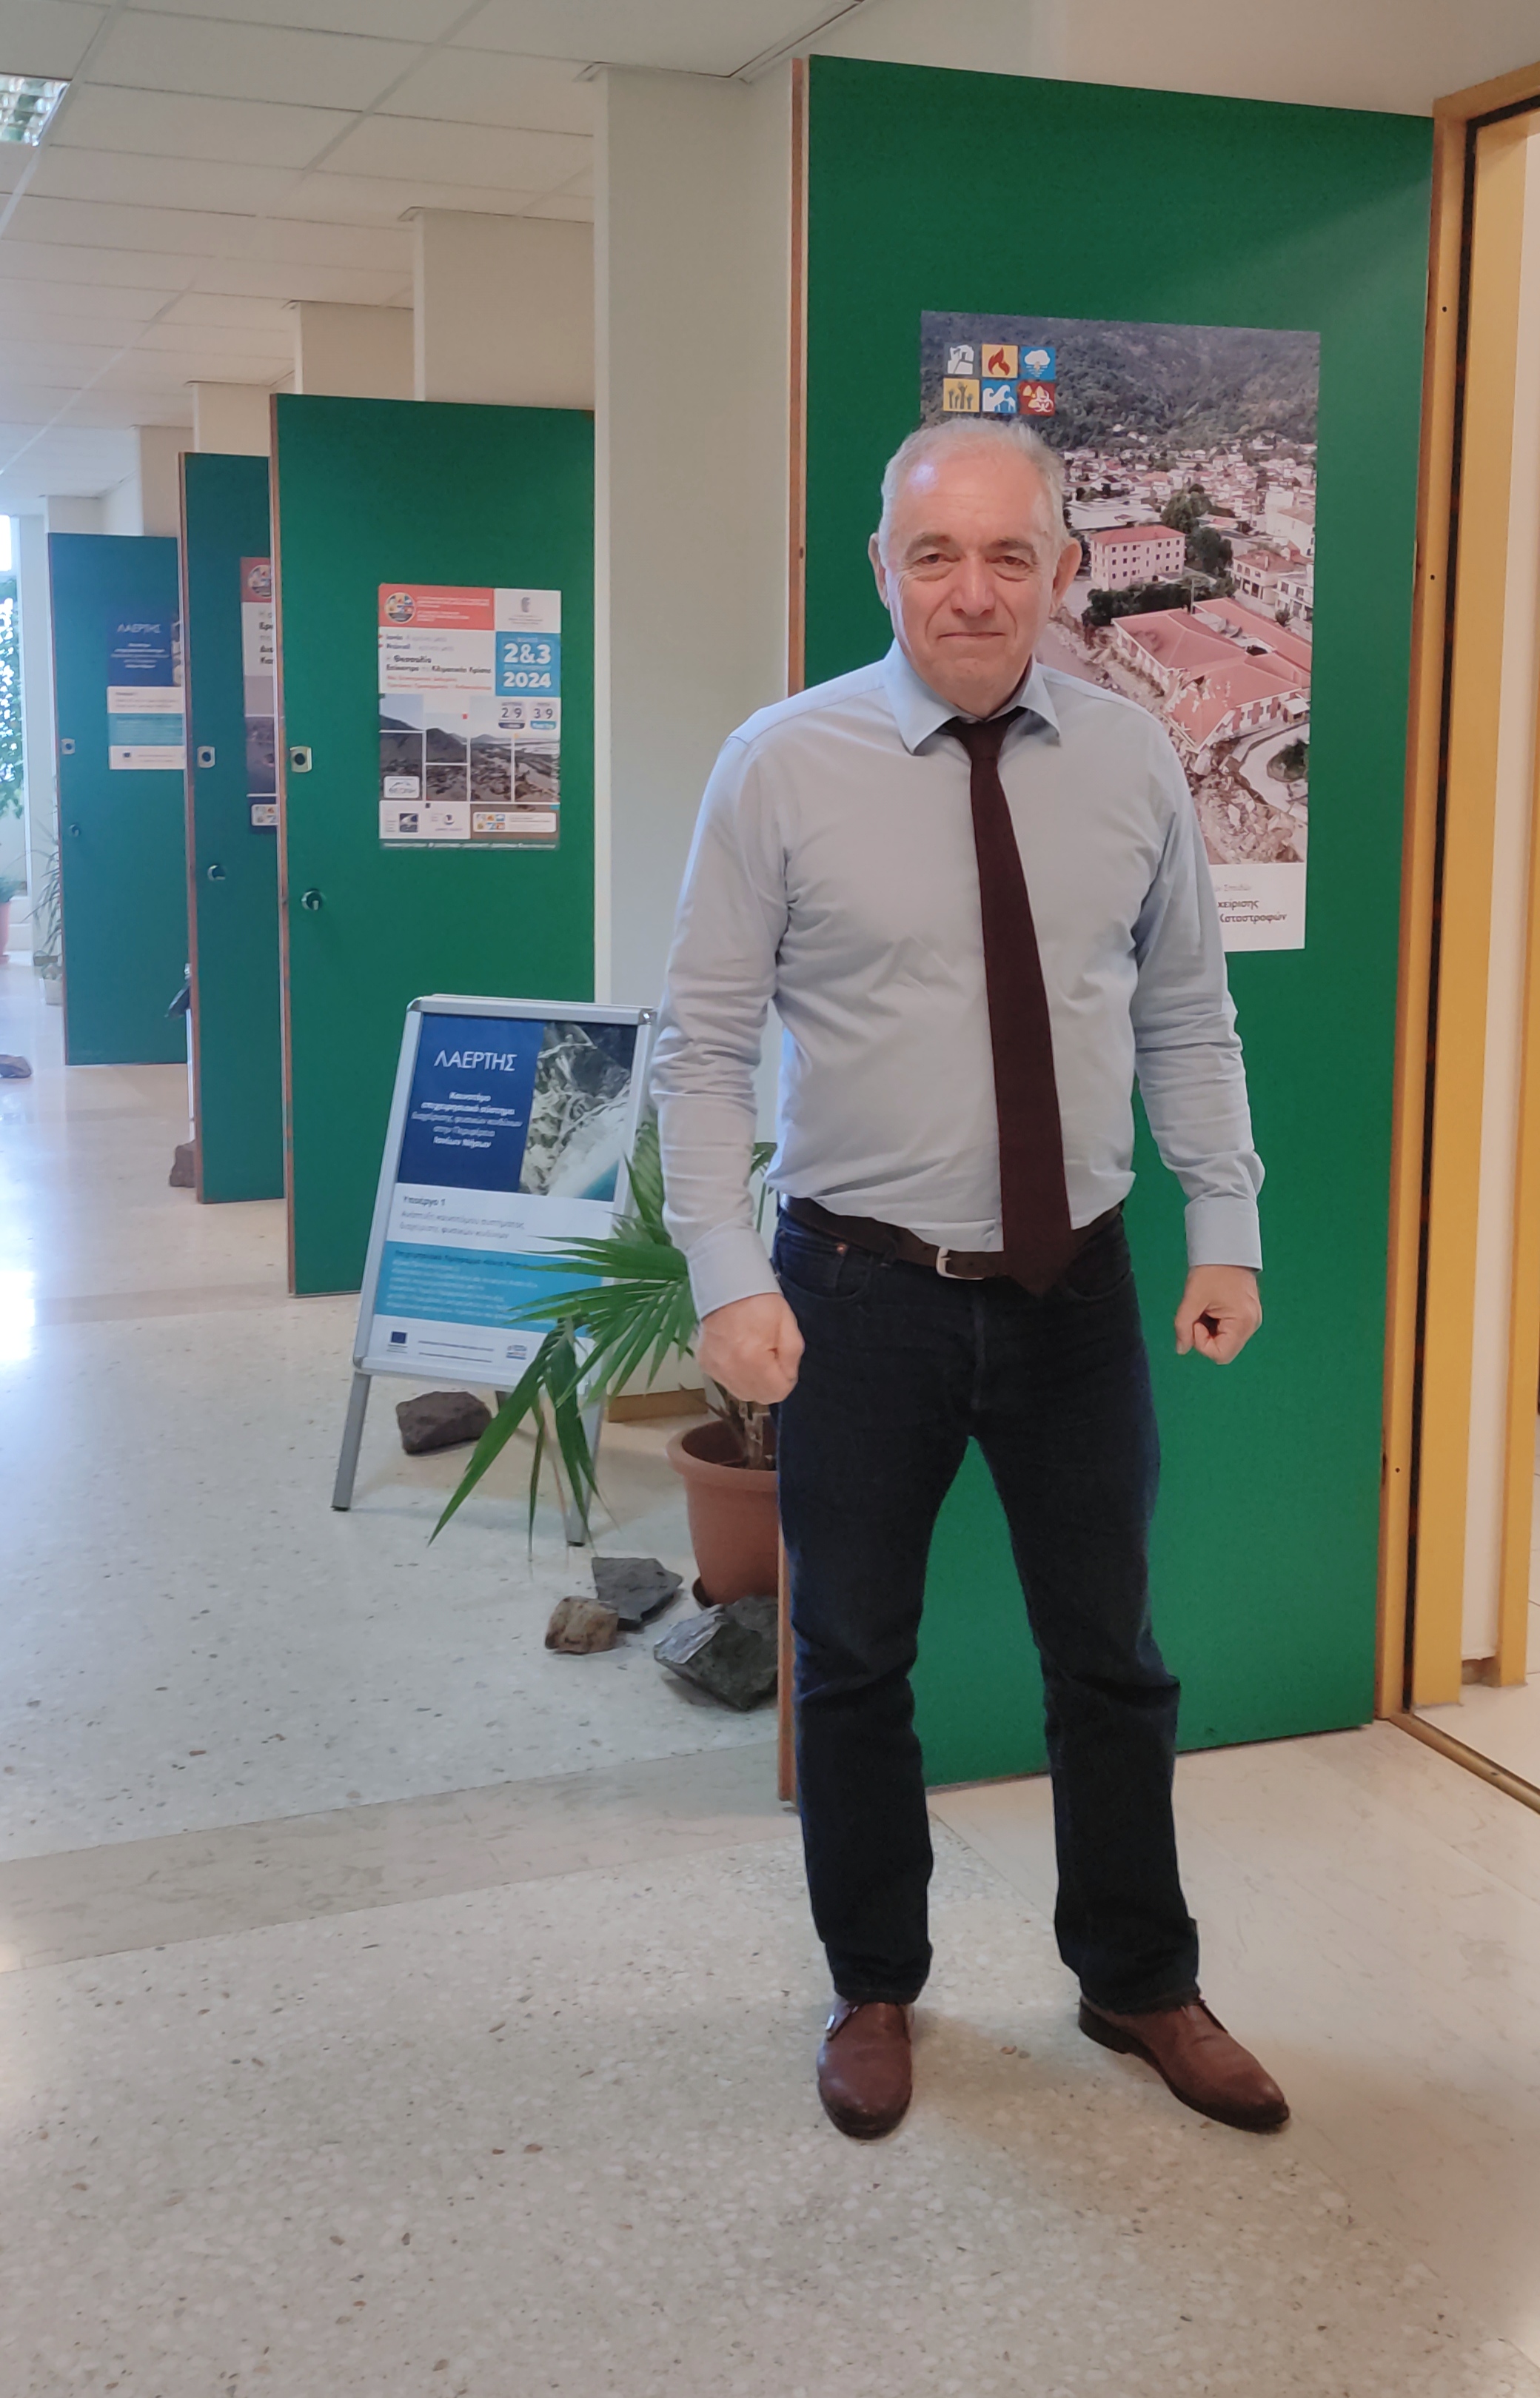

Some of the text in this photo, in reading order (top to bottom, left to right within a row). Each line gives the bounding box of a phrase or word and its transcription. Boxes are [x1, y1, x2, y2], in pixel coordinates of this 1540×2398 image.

[503, 643, 552, 664] 2&3
[503, 671, 552, 689] 2024
[434, 1050, 518, 1071] ΛΑΕΡΤΗΣ
